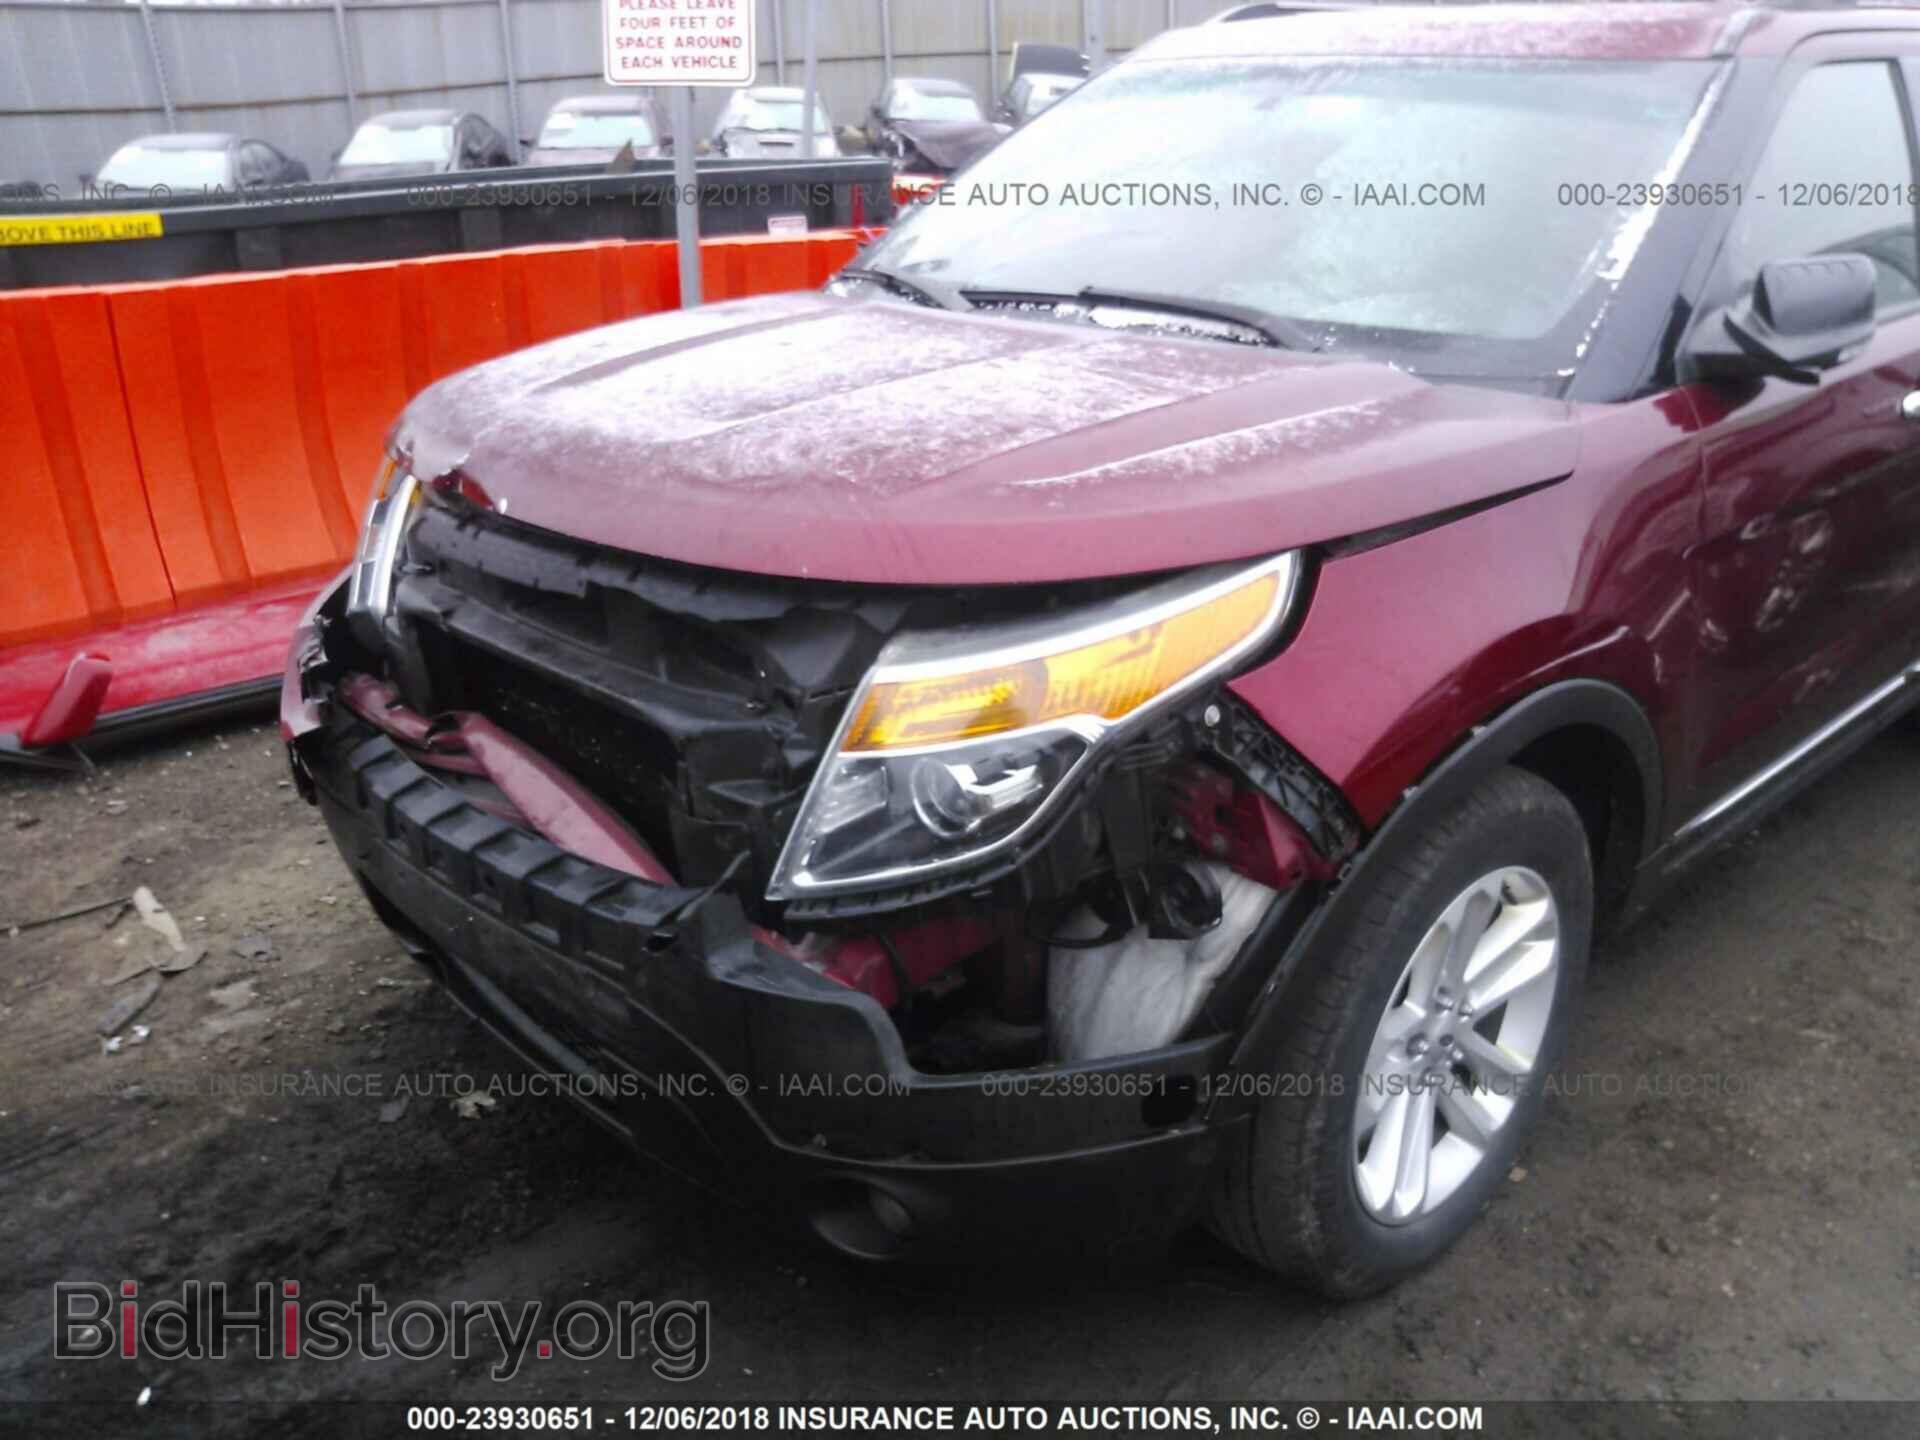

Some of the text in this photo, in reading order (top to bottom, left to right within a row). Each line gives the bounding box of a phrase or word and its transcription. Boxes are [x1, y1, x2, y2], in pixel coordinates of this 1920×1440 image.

[619, 0, 736, 10] PLEASE LEAVE
[620, 16, 736, 30] FOUR FEET OF
[616, 36, 743, 49] SPACE AROUND
[621, 55, 737, 69] EACH VEHICLE
